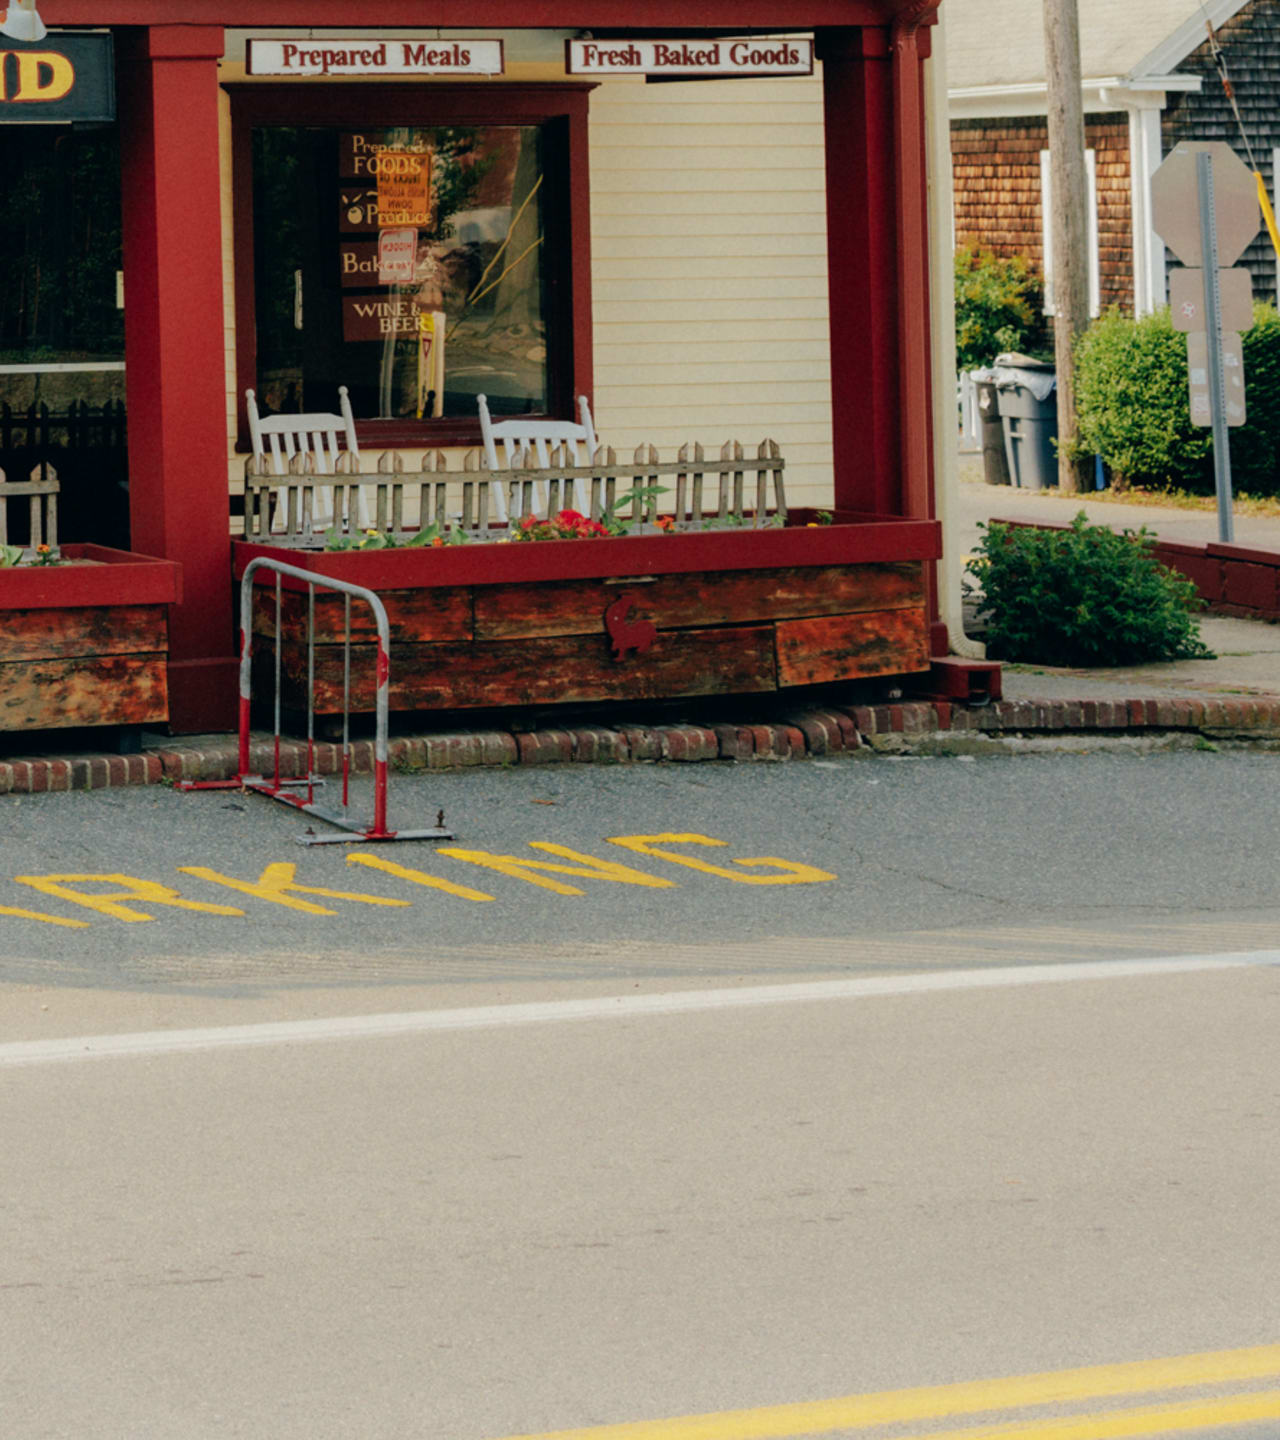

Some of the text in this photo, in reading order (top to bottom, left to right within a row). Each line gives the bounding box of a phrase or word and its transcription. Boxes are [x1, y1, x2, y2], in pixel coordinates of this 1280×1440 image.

[281, 43, 472, 74] Prepared Meals
[581, 43, 800, 67] Fresh Baked Goods
[352, 135, 425, 154] Prepared
[353, 156, 421, 175] FOODS
[366, 203, 433, 225] Produce
[352, 301, 422, 318] WINE &
[380, 317, 430, 333] BEER
